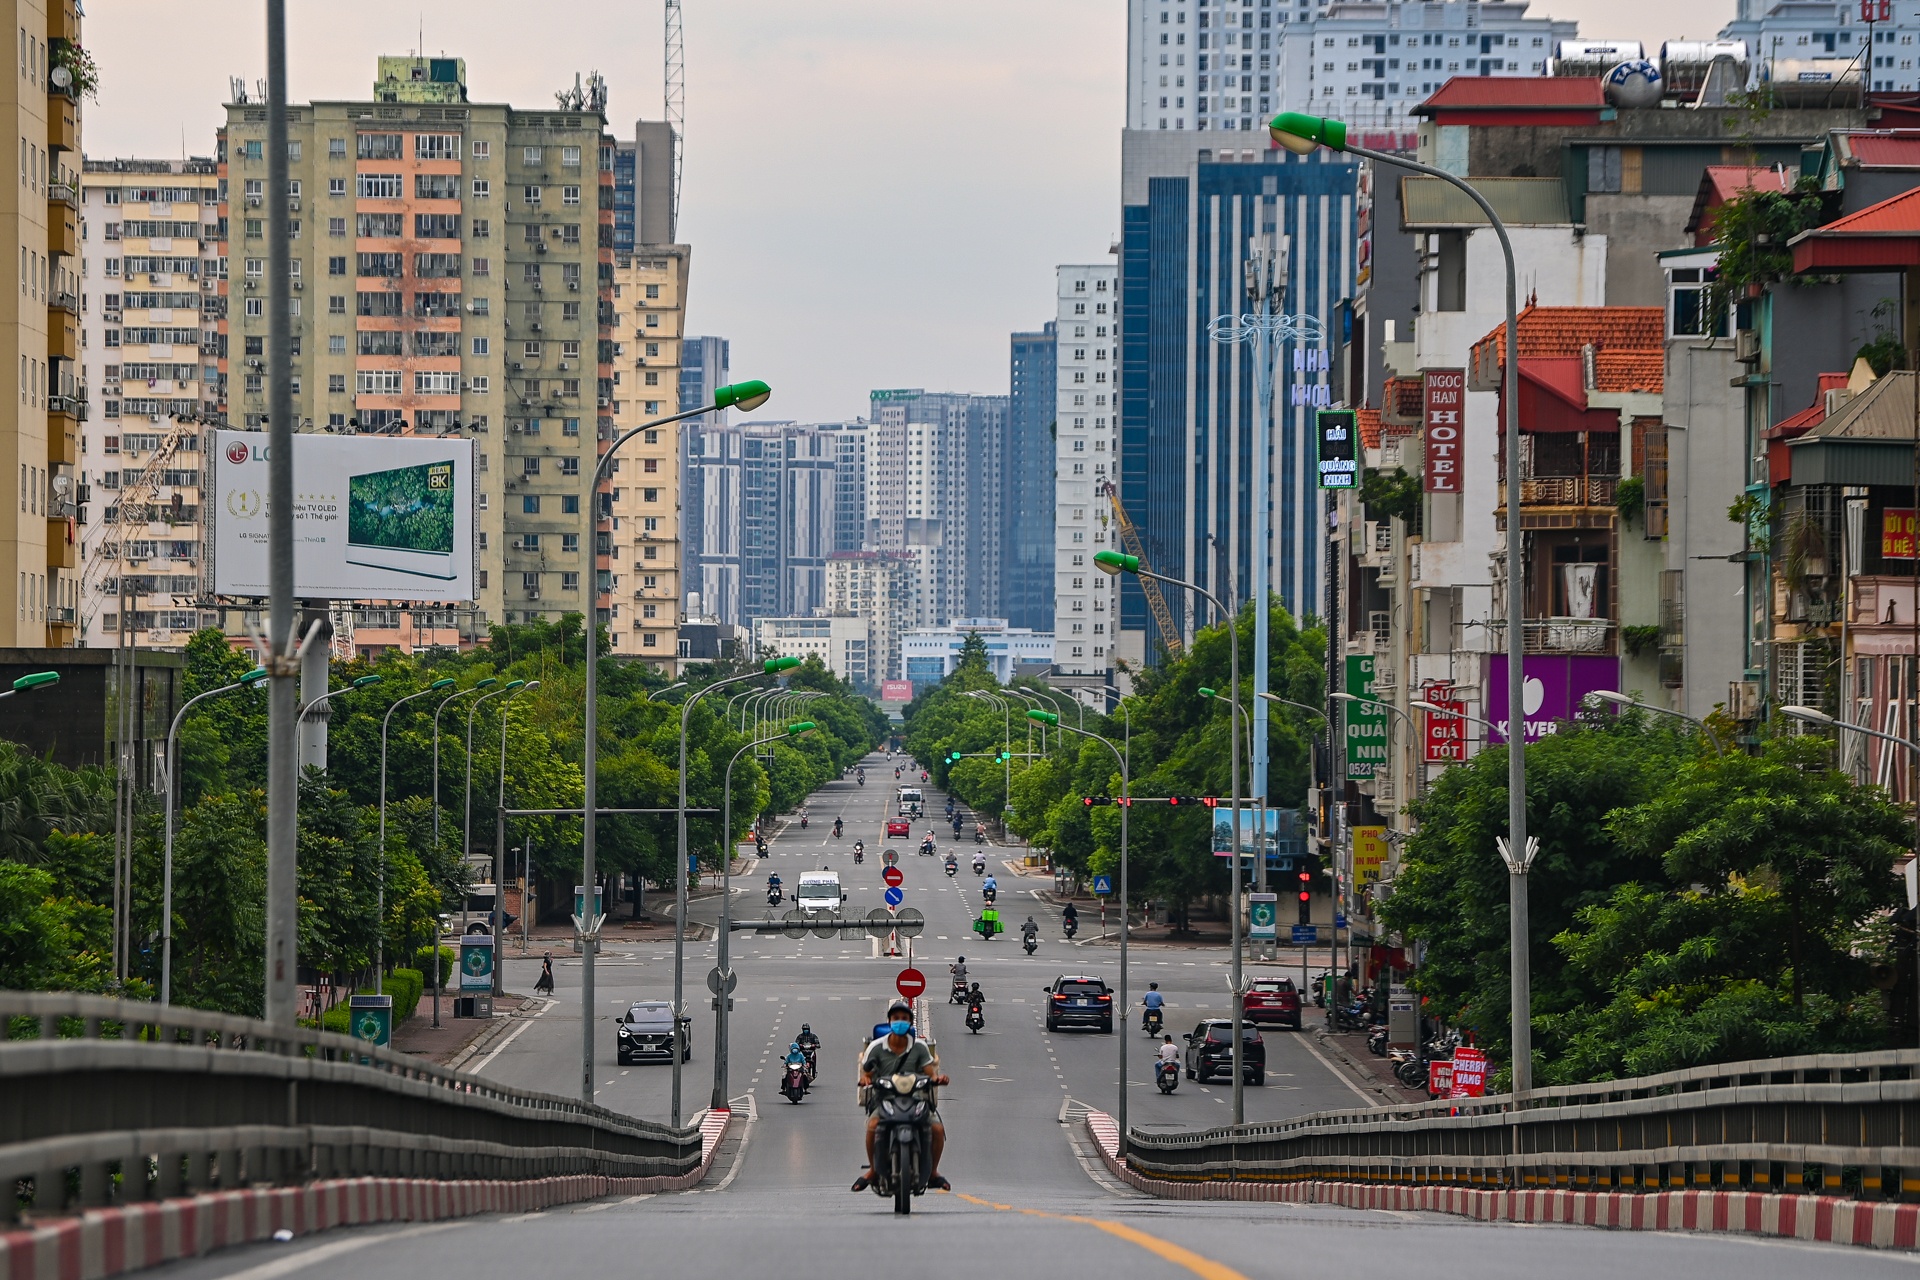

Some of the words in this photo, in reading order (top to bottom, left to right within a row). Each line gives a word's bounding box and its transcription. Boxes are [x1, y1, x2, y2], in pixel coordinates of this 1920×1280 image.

[1294, 348, 1329, 372] NHA
[1291, 383, 1331, 407] KHOA
[1432, 391, 1457, 403] HAN
[1429, 410, 1459, 490] HOTEL
[1320, 456, 1355, 473] QUẢNG
[431, 475, 447, 487] 8K
[1324, 474, 1351, 486] NINH
[1348, 720, 1387, 738] QUẢ
[1432, 724, 1459, 739] GIÁ
[1498, 720, 1558, 737] KVER
[1431, 740, 1460, 757] TỐT
[1349, 763, 1371, 775] 0523
[1203, 797, 1217, 807] 41
[1361, 830, 1378, 838] PHO
[1356, 857, 1364, 865] IN
[1454, 1059, 1487, 1073] CHERRY
